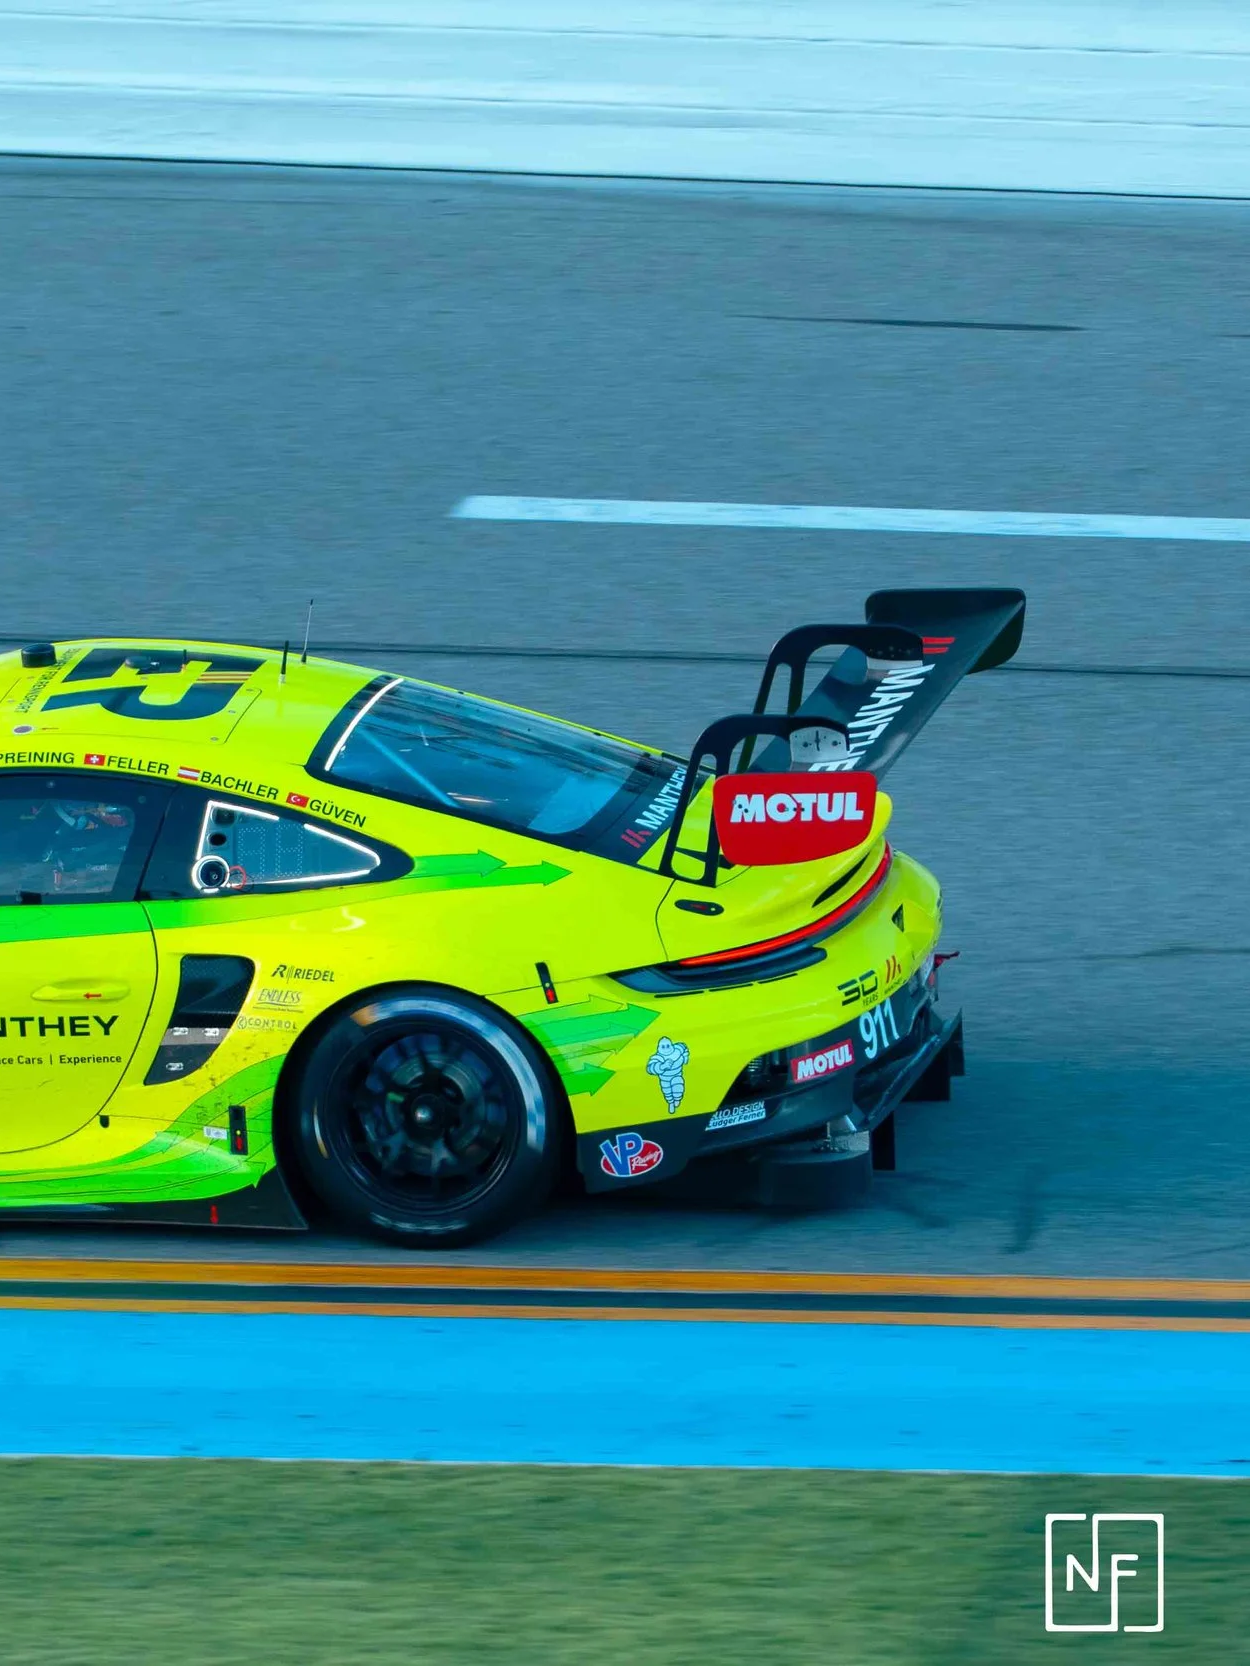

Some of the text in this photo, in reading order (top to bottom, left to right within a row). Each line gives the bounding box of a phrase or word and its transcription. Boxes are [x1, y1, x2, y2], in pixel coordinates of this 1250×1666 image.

[808, 663, 936, 772] MANTHE
[106, 755, 170, 775] FELLER
[200, 771, 280, 800] BACHLER
[308, 799, 367, 828] GÜVEN
[730, 791, 865, 823] MOTUL
[293, 968, 335, 982] RIEDEL
[837, 970, 878, 1006] 30
[257, 988, 302, 1004] ENDLESS
[862, 992, 879, 1007] YEARS
[247, 1017, 298, 1030] CONTROL
[859, 998, 900, 1059] 911
[17, 1054, 43, 1065] Cars
[59, 1054, 122, 1066] Experience
[797, 1044, 852, 1080] MOTUL
[600, 1132, 661, 1177] VP Racing
